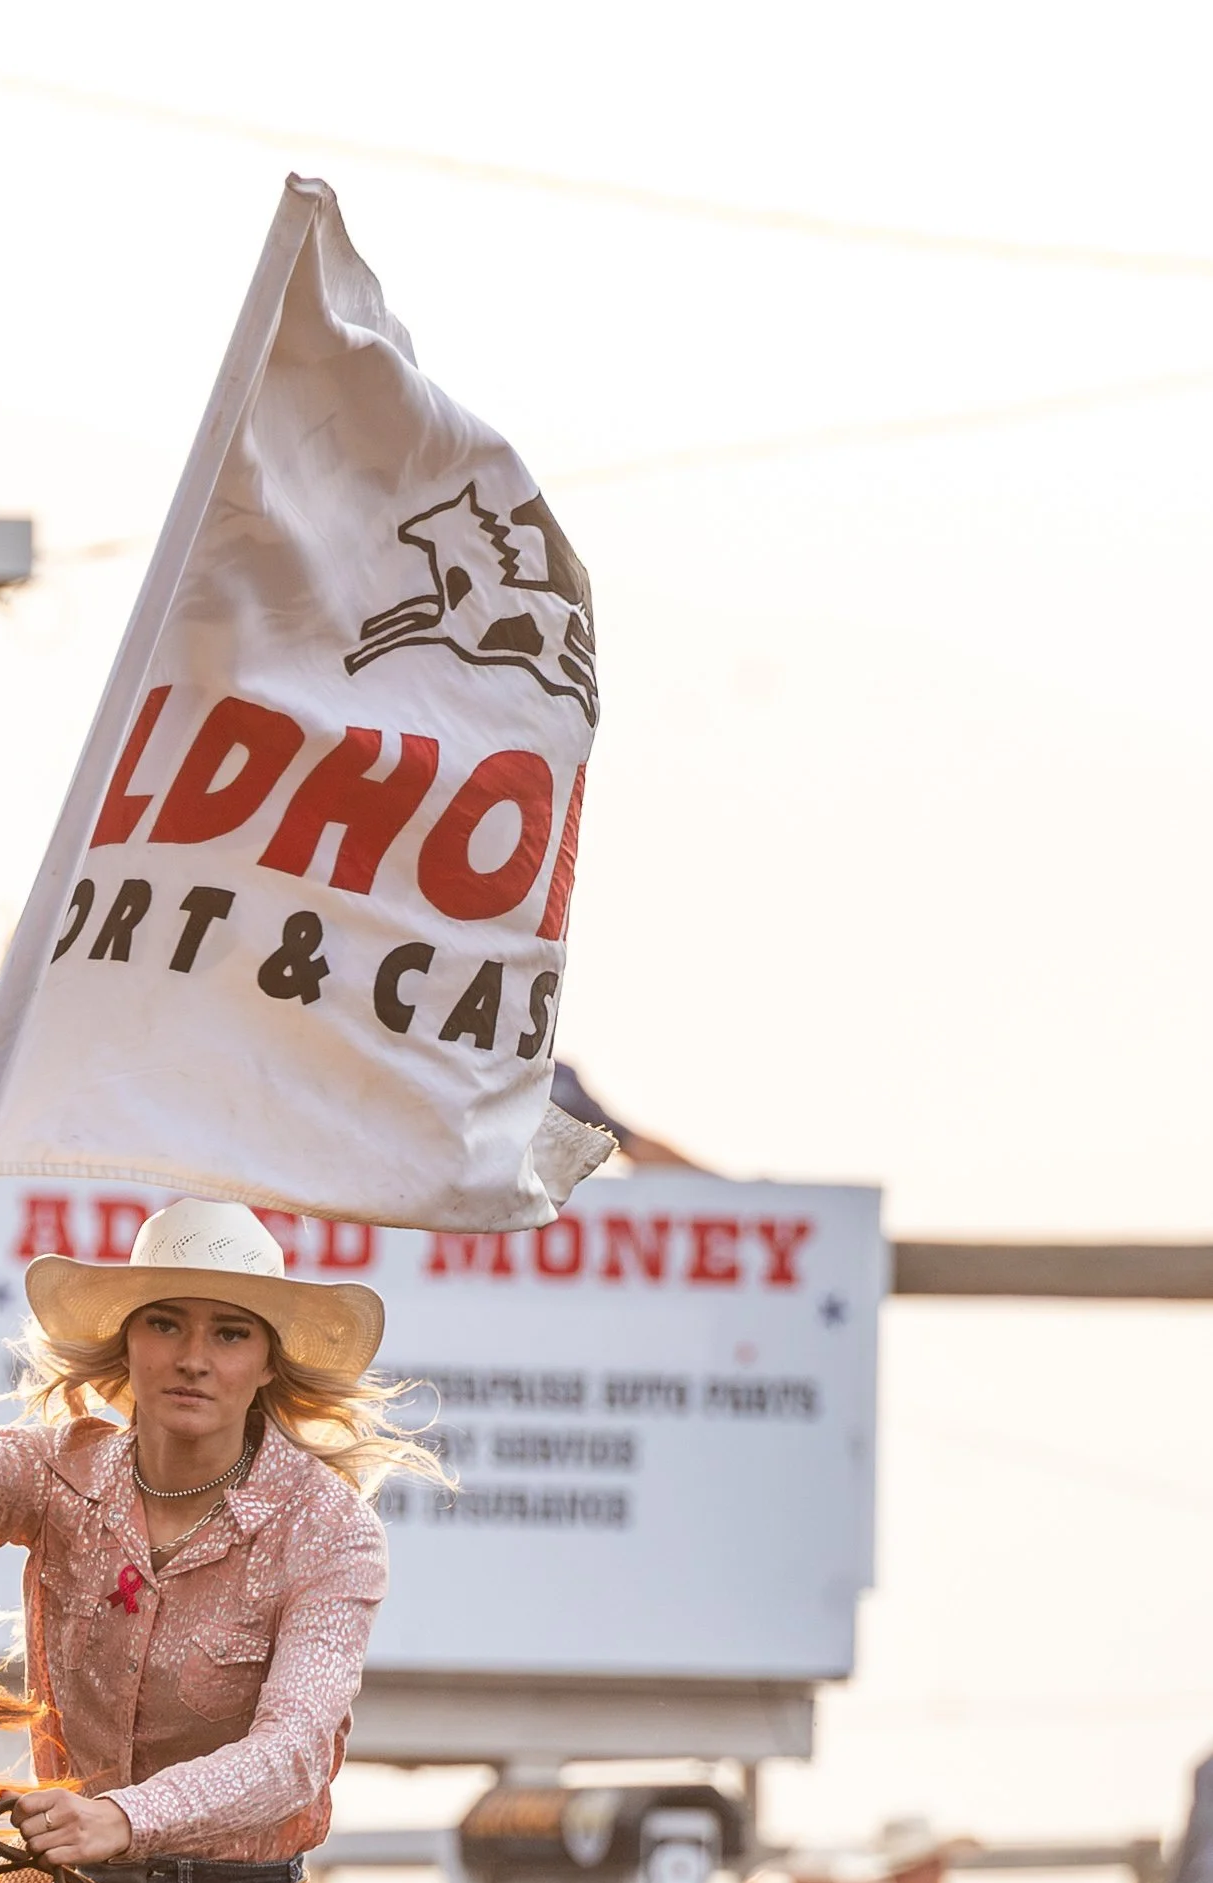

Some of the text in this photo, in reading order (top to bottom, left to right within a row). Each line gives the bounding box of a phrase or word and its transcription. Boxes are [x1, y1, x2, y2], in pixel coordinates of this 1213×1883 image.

[257, 911, 330, 1005] &
[373, 942, 560, 1061] CAS
[16, 1195, 811, 1285] ADD MONEY
